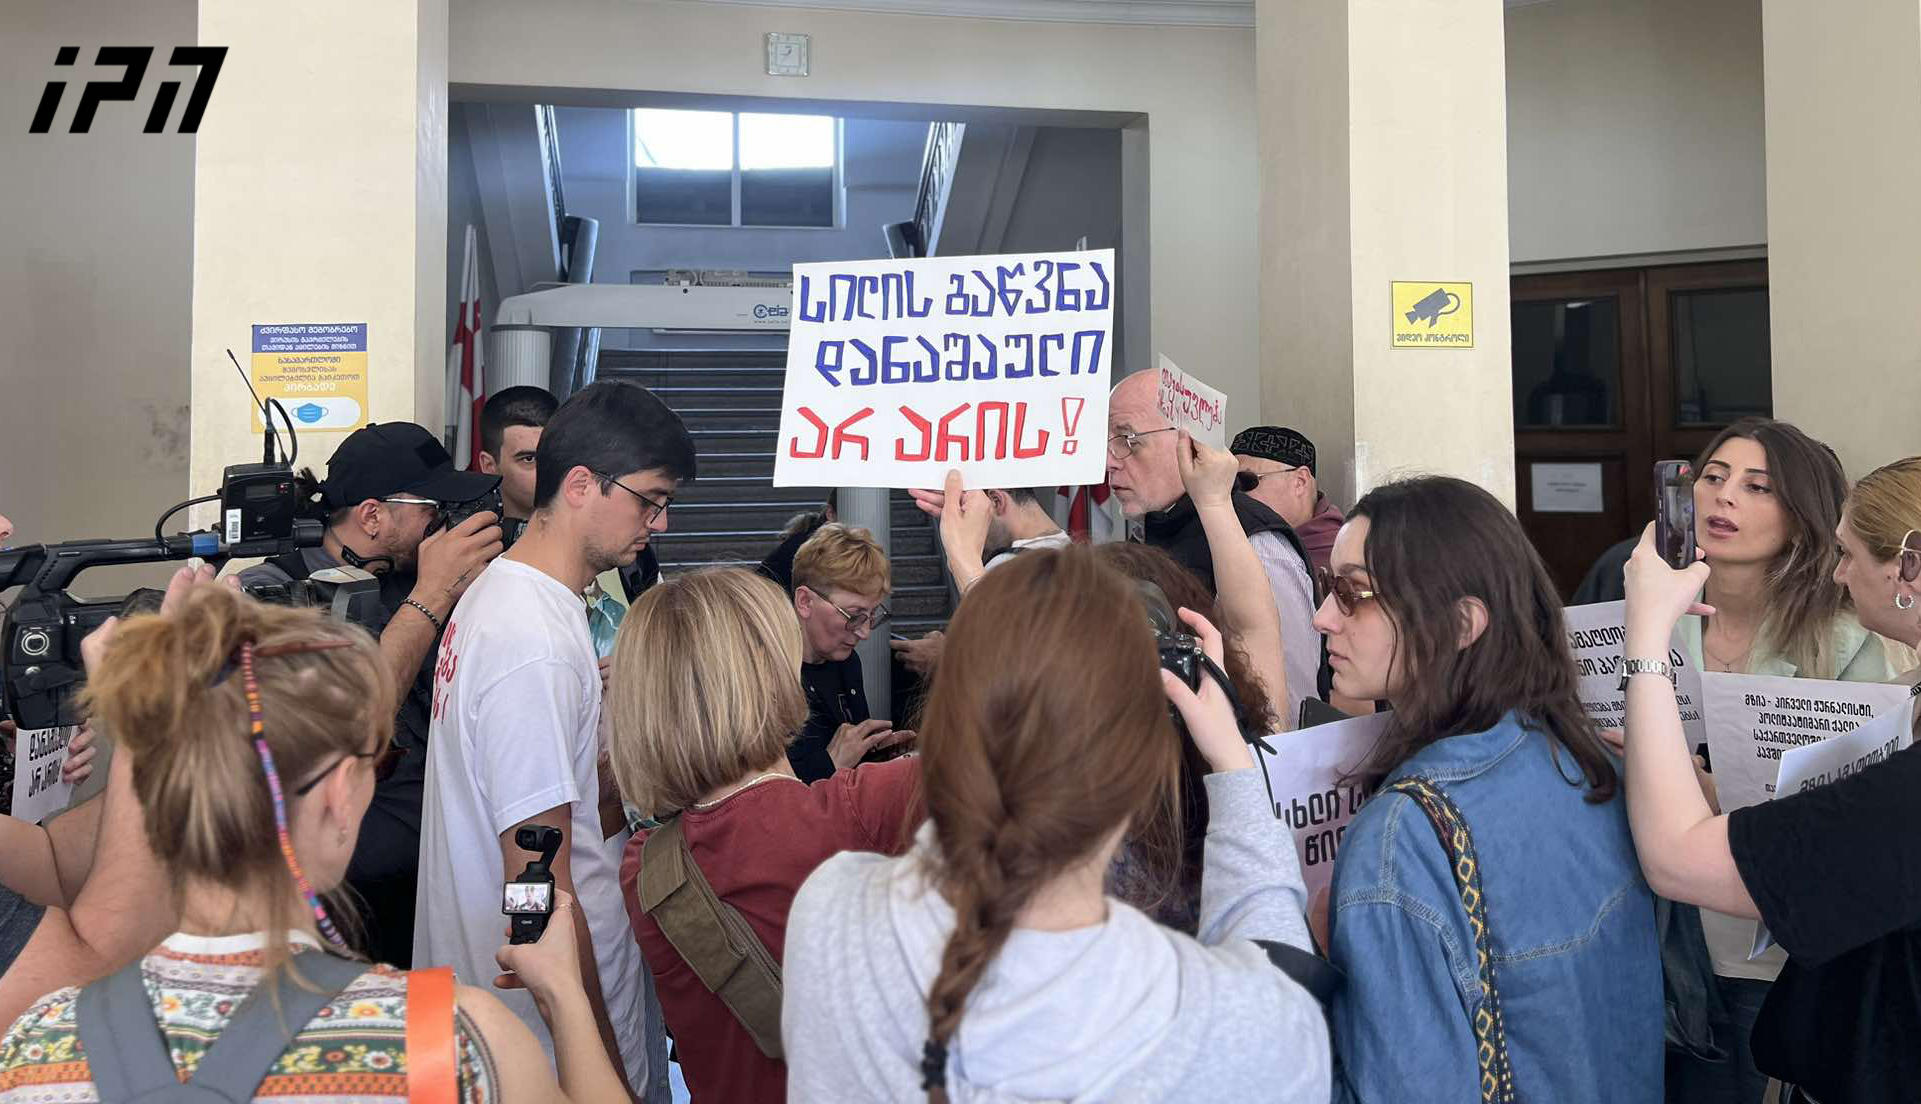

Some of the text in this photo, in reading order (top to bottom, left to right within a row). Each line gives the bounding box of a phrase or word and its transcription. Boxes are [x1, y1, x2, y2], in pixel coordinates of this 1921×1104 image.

[799, 260, 1110, 323] სილის გაწვნა
[815, 330, 1106, 388] დანაშაული
[789, 406, 875, 461] არ
[1745, 694, 1767, 706] მზია
[1775, 696, 1811, 712] პირველი
[1814, 699, 1874, 718] ჟურნალისტი,
[1759, 712, 1831, 731] პოლიტპატიმარი
